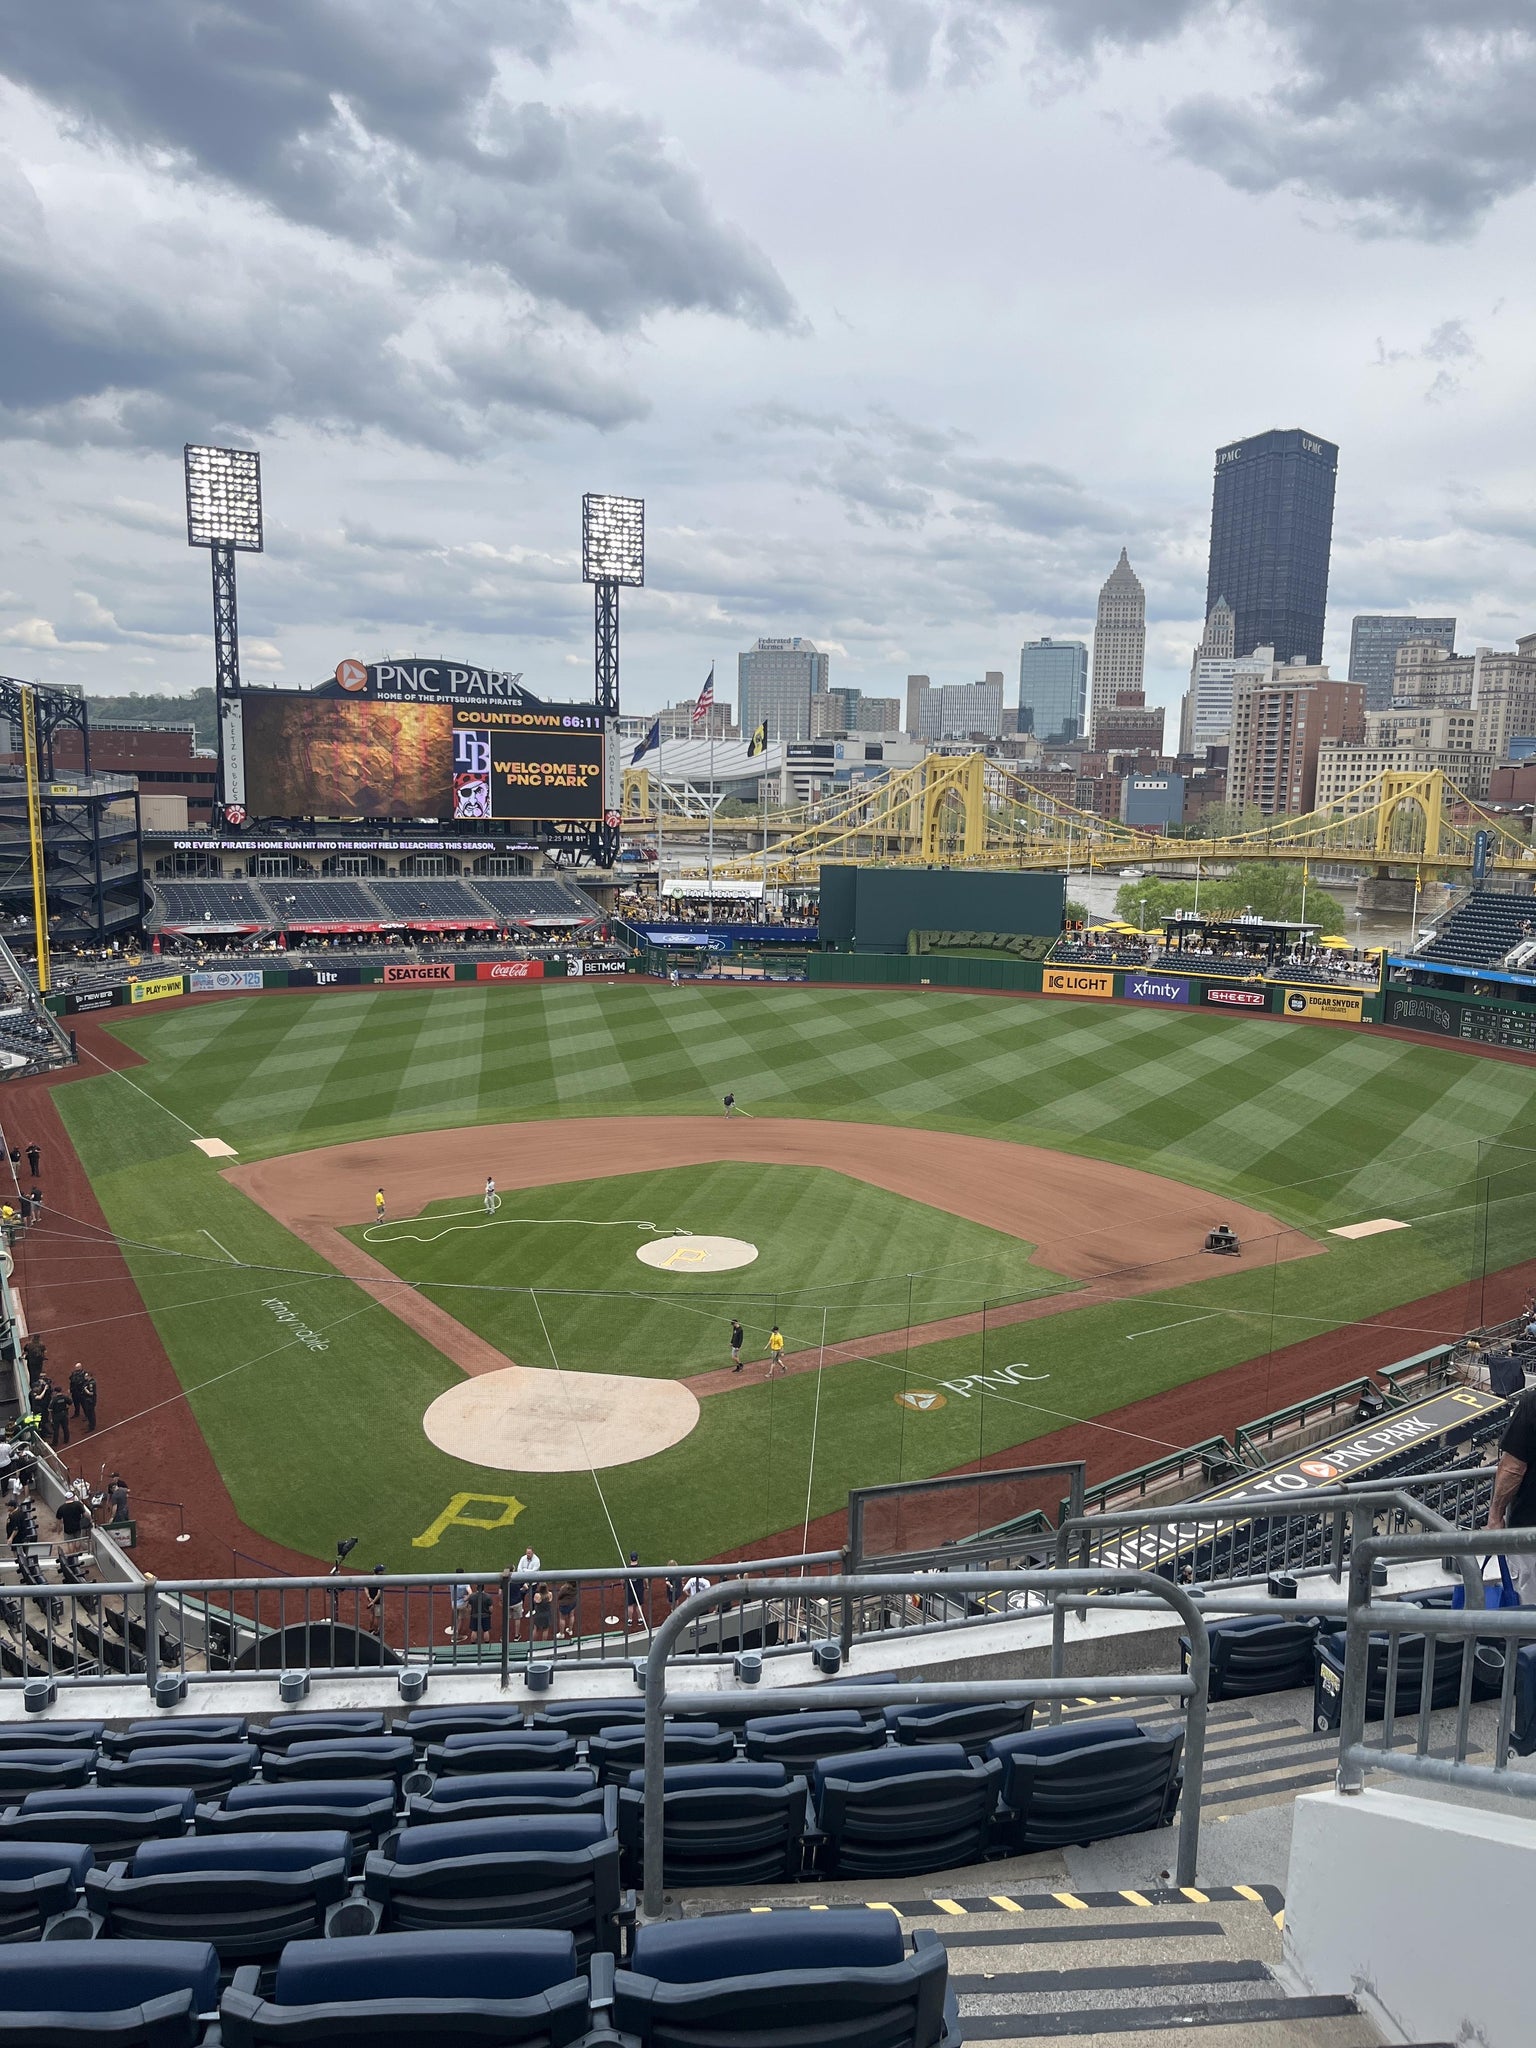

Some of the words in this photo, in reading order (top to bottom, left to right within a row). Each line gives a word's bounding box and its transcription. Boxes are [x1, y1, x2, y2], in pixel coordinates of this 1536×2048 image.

[1302, 438, 1323, 456] UPMC
[1215, 449, 1241, 466] UPMC
[373, 665, 440, 692] PNC
[448, 669, 525, 697] PARK
[377, 692, 402, 700] HOME
[404, 693, 416, 701] OF
[419, 694, 435, 702] THE
[437, 695, 487, 705] PITTSBURGH
[489, 698, 522, 706] PIRATES
[457, 711, 561, 727] COUNTDOWN
[562, 716, 600, 729] 66:11
[493, 761, 577, 775] WELCOME
[579, 764, 600, 776] TO
[507, 775, 542, 786] PNC
[545, 776, 588, 787] PARK
[192, 842, 220, 850] EVERY
[400, 842, 444, 850] BLEACHERS
[444, 842, 462, 850] THIS
[463, 842, 496, 851] SEASON,
[686, 889, 704, 897] FAT
[708, 889, 751, 898] HEAD'S
[1240, 916, 1263, 926] TIME
[919, 930, 1056, 961] PIRATES
[388, 967, 451, 981] SEATGEEK
[585, 962, 626, 971] BETMGM
[243, 972, 261, 985] 125
[316, 972, 338, 985] Lite
[1049, 975, 1064, 989] IC
[1067, 978, 1107, 991] LIGHT
[145, 985, 161, 995] PLAY
[167, 981, 181, 991] WIN!
[1133, 980, 1180, 999] xfinity
[1211, 991, 1260, 1004] SHEETZ
[1309, 996, 1331, 1006] EDGAR
[1332, 998, 1360, 1009] SNYDER
[1393, 1000, 1450, 1029] PIRATES
[659, 1247, 711, 1268] P
[936, 1363, 1050, 1398] PNC
[1253, 1473, 1309, 1494] TO
[1321, 1440, 1386, 1468] PNC
[1370, 1415, 1439, 1447] PARK
[411, 1492, 528, 1548] P
